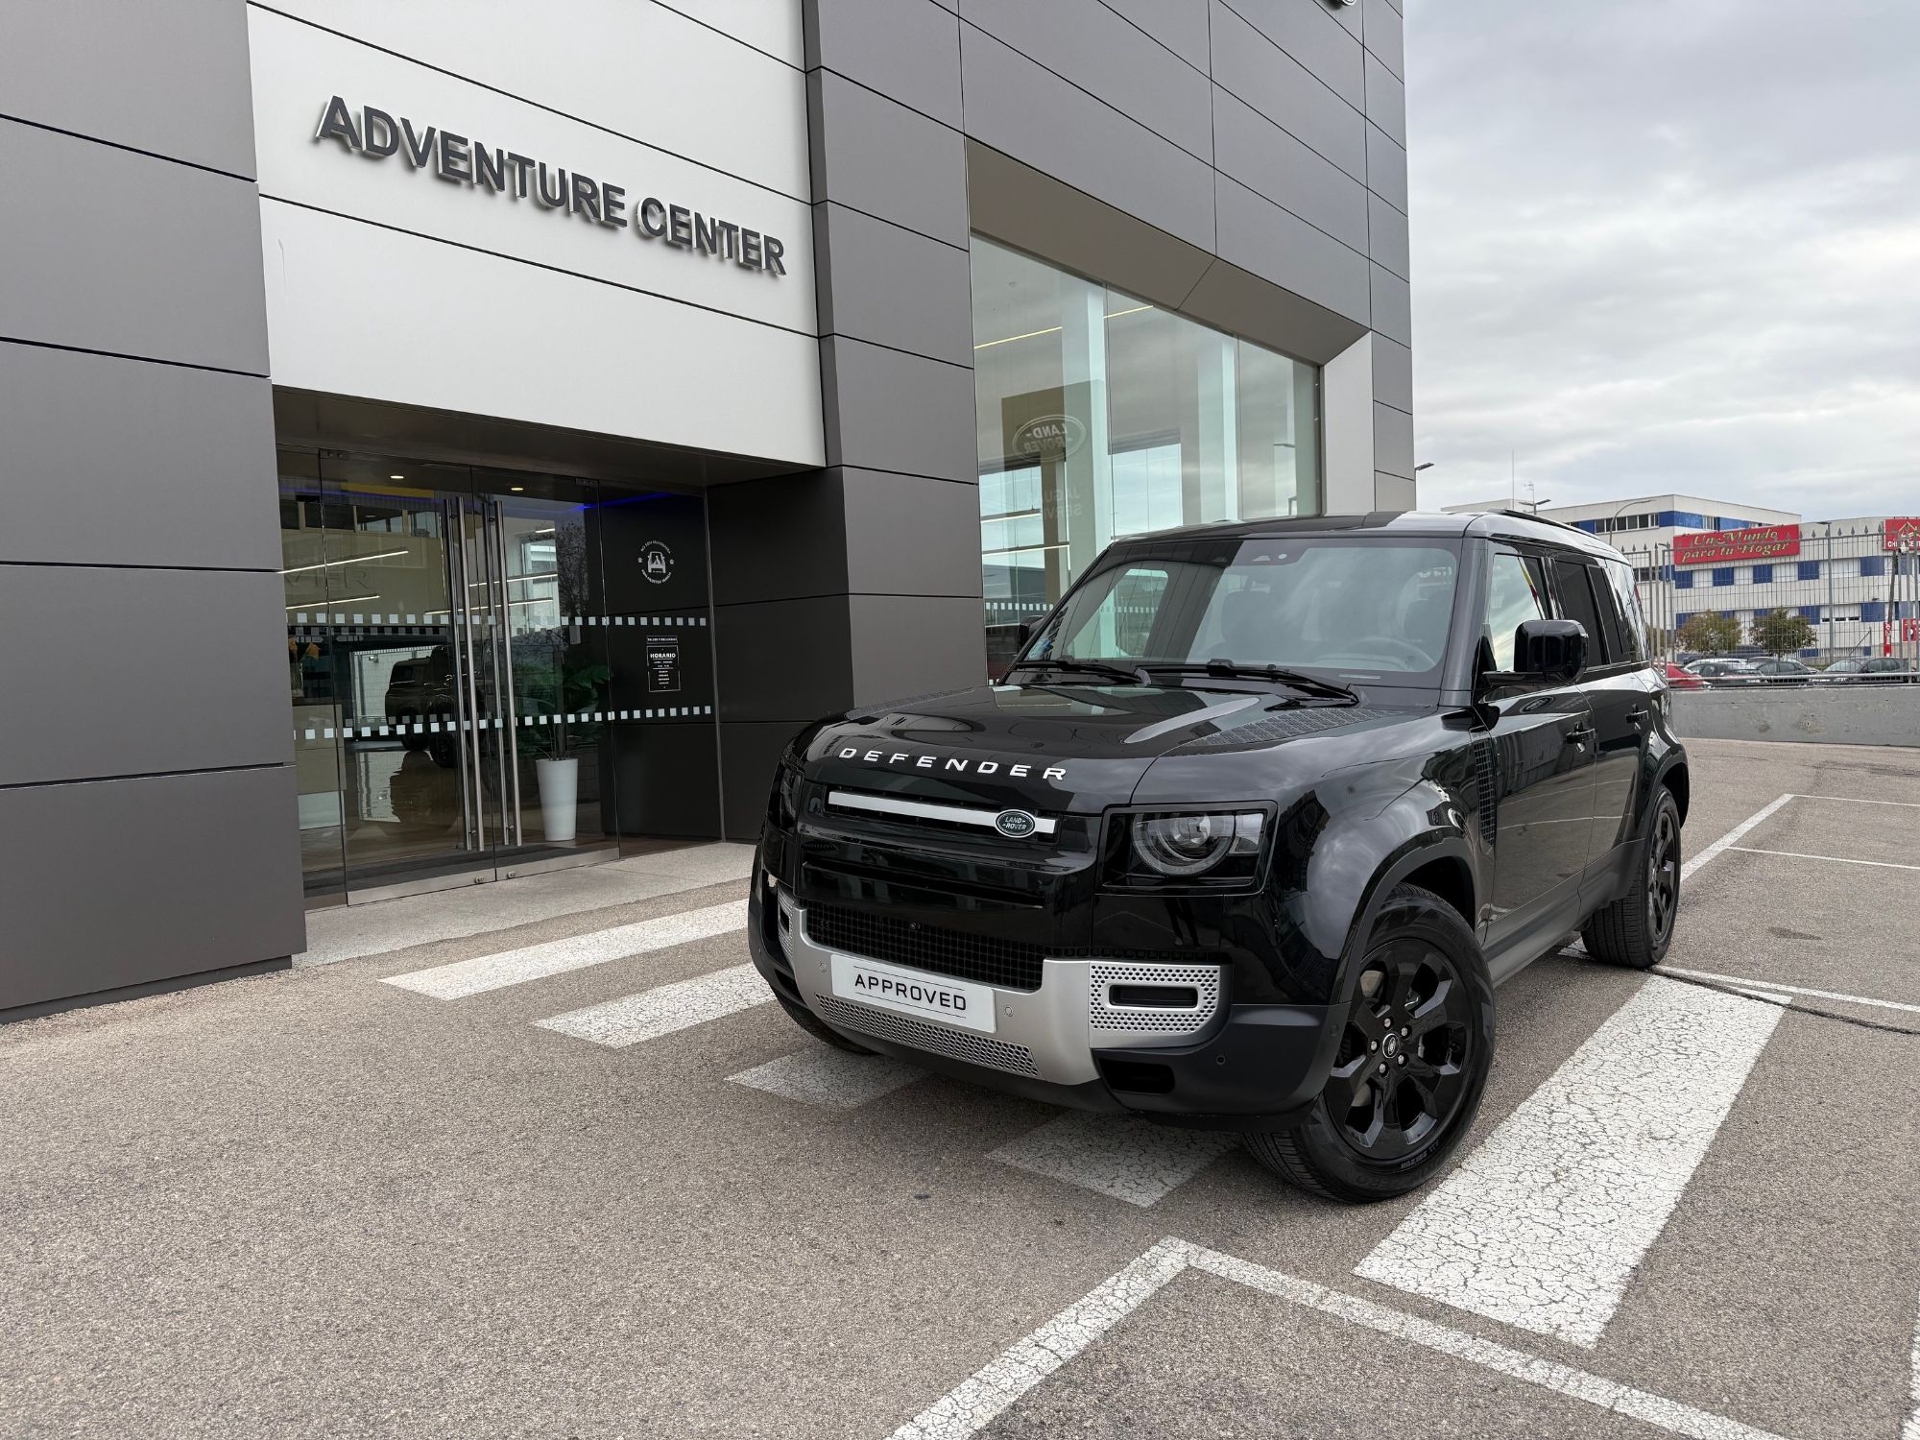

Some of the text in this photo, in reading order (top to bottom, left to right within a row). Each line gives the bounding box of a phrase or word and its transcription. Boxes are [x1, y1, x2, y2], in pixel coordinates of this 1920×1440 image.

[315, 95, 787, 275] ADVENTURE CENTER
[1718, 529, 1778, 544] Mundo
[1682, 543, 1789, 563] para tu Hogar
[650, 652, 677, 660] HORARIO
[839, 748, 1067, 781] DEFENDER
[855, 973, 967, 1012] APPROVED
